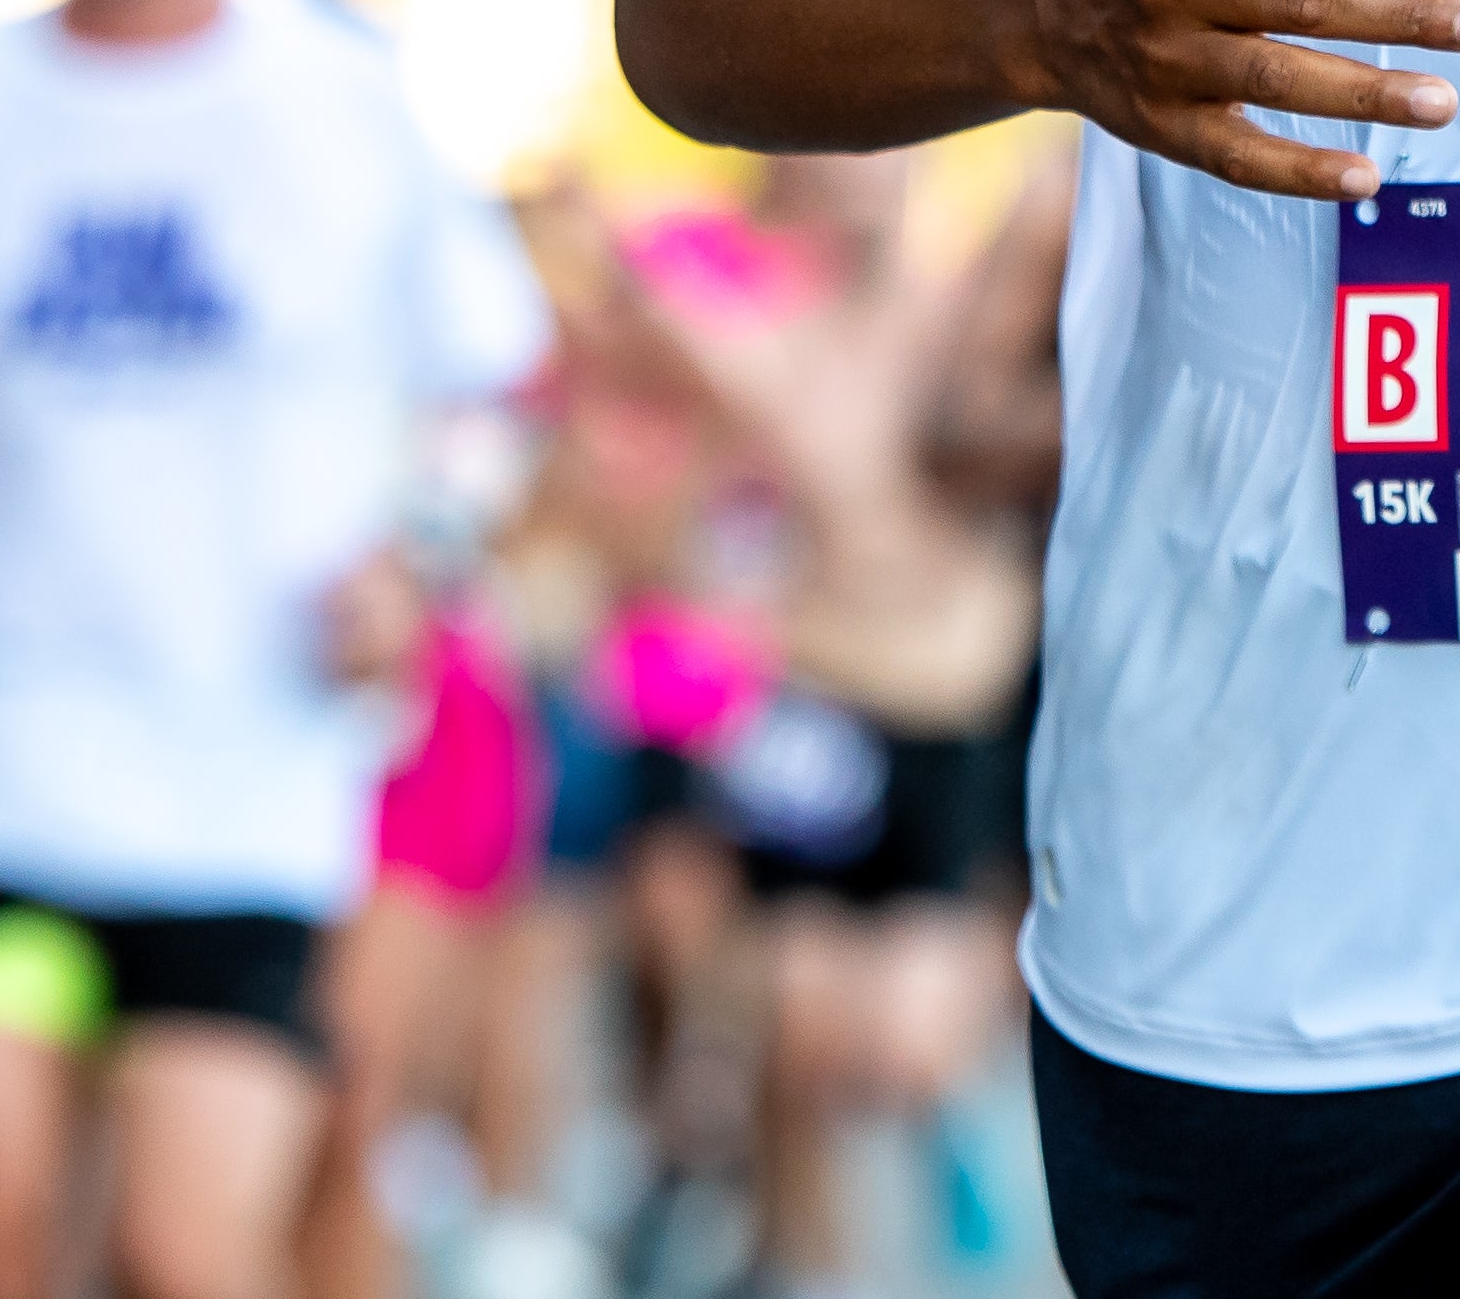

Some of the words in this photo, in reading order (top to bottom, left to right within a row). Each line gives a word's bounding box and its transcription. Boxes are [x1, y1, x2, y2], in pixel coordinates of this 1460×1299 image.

[1409, 198, 1448, 218] 4378
[1366, 312, 1417, 429] B
[1353, 478, 1438, 525] 15K
